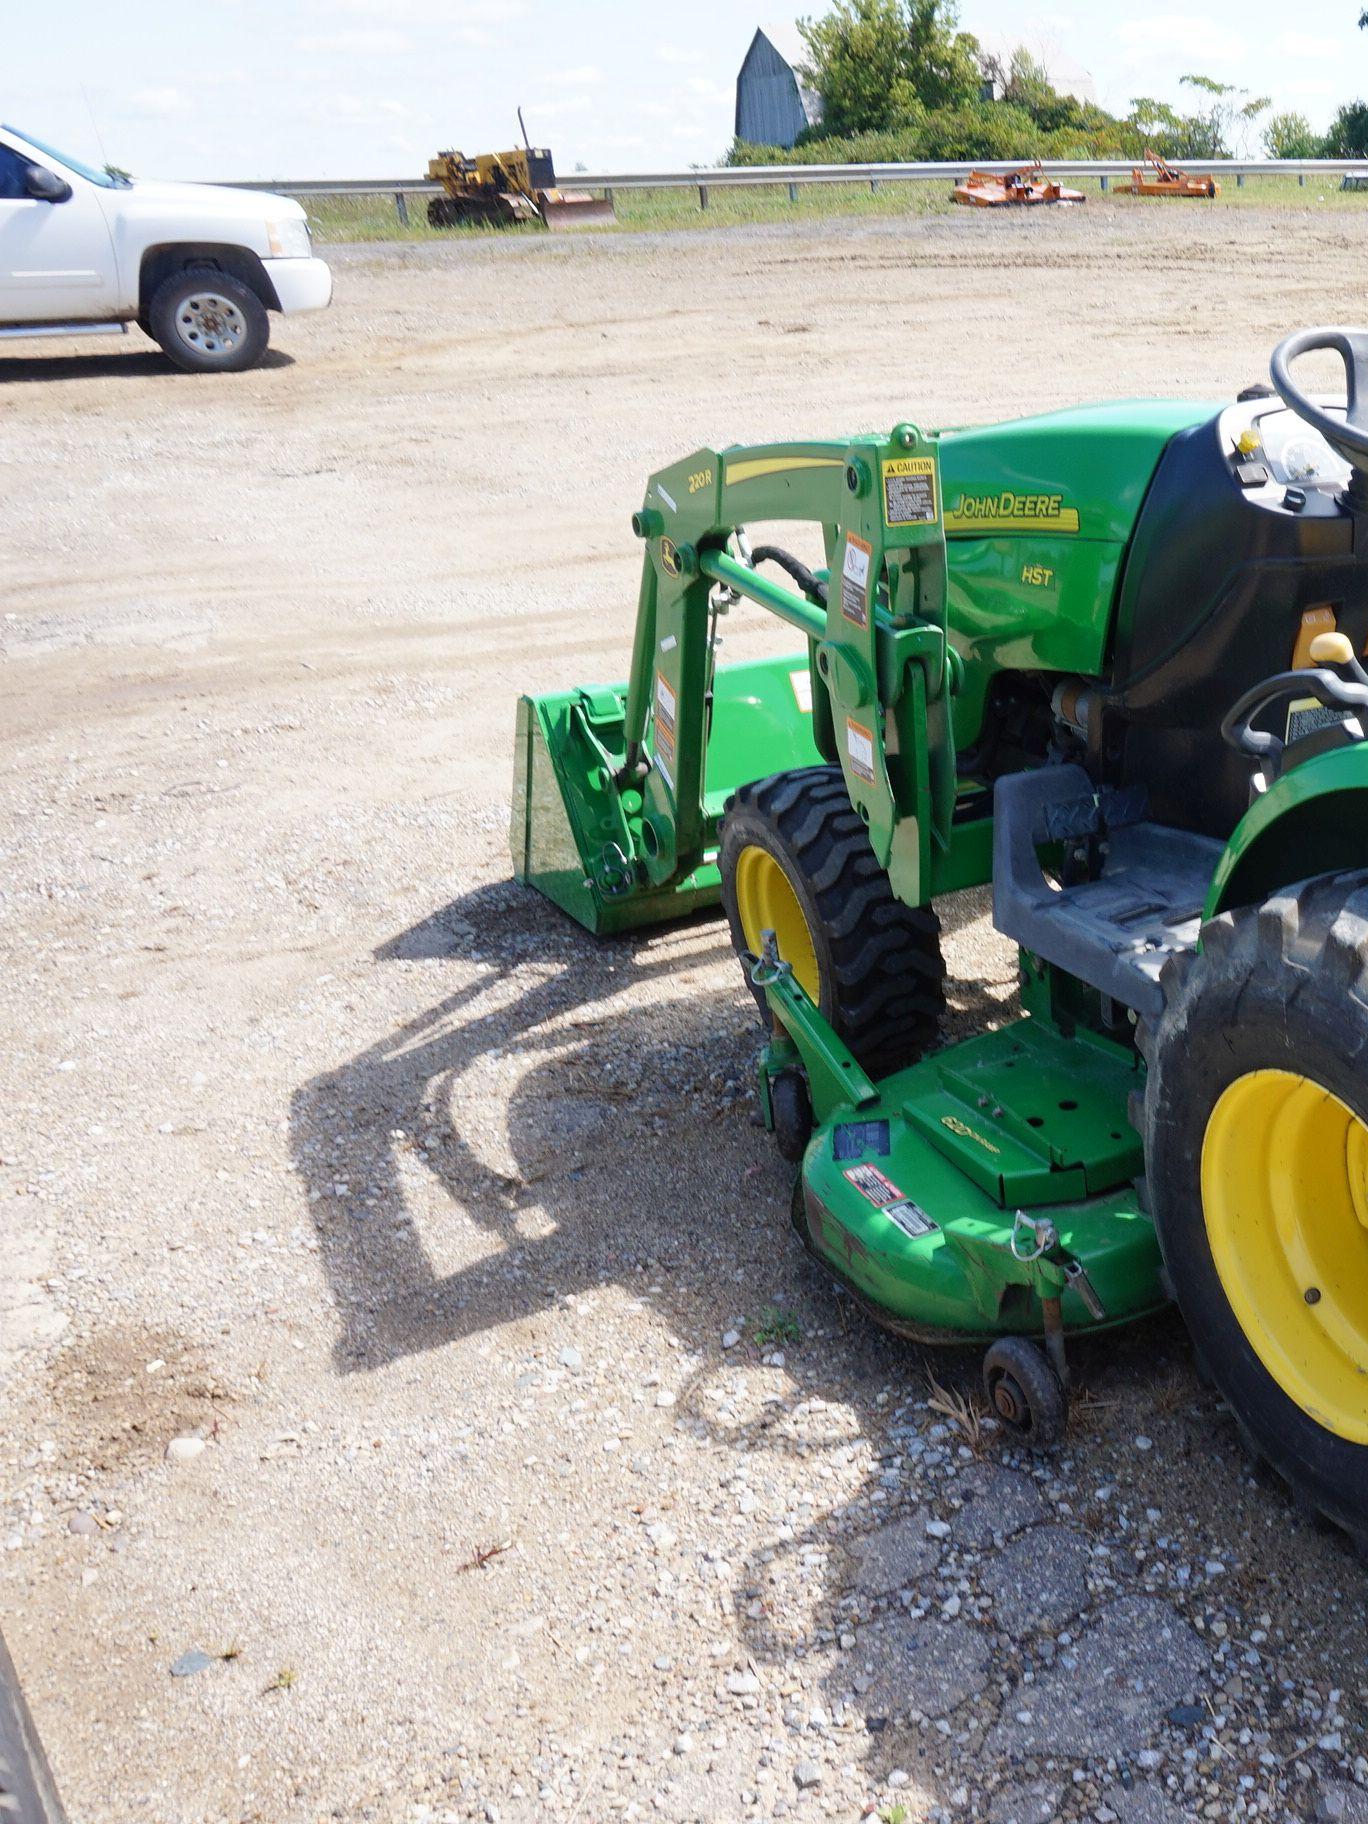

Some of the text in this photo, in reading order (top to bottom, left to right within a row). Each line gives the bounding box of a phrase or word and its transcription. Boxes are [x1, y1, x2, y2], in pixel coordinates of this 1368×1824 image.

[897, 461, 932, 473] CAUTION
[953, 493, 998, 518] JOHN
[998, 492, 1062, 518] DEERE
[1022, 565, 1053, 586] HST
